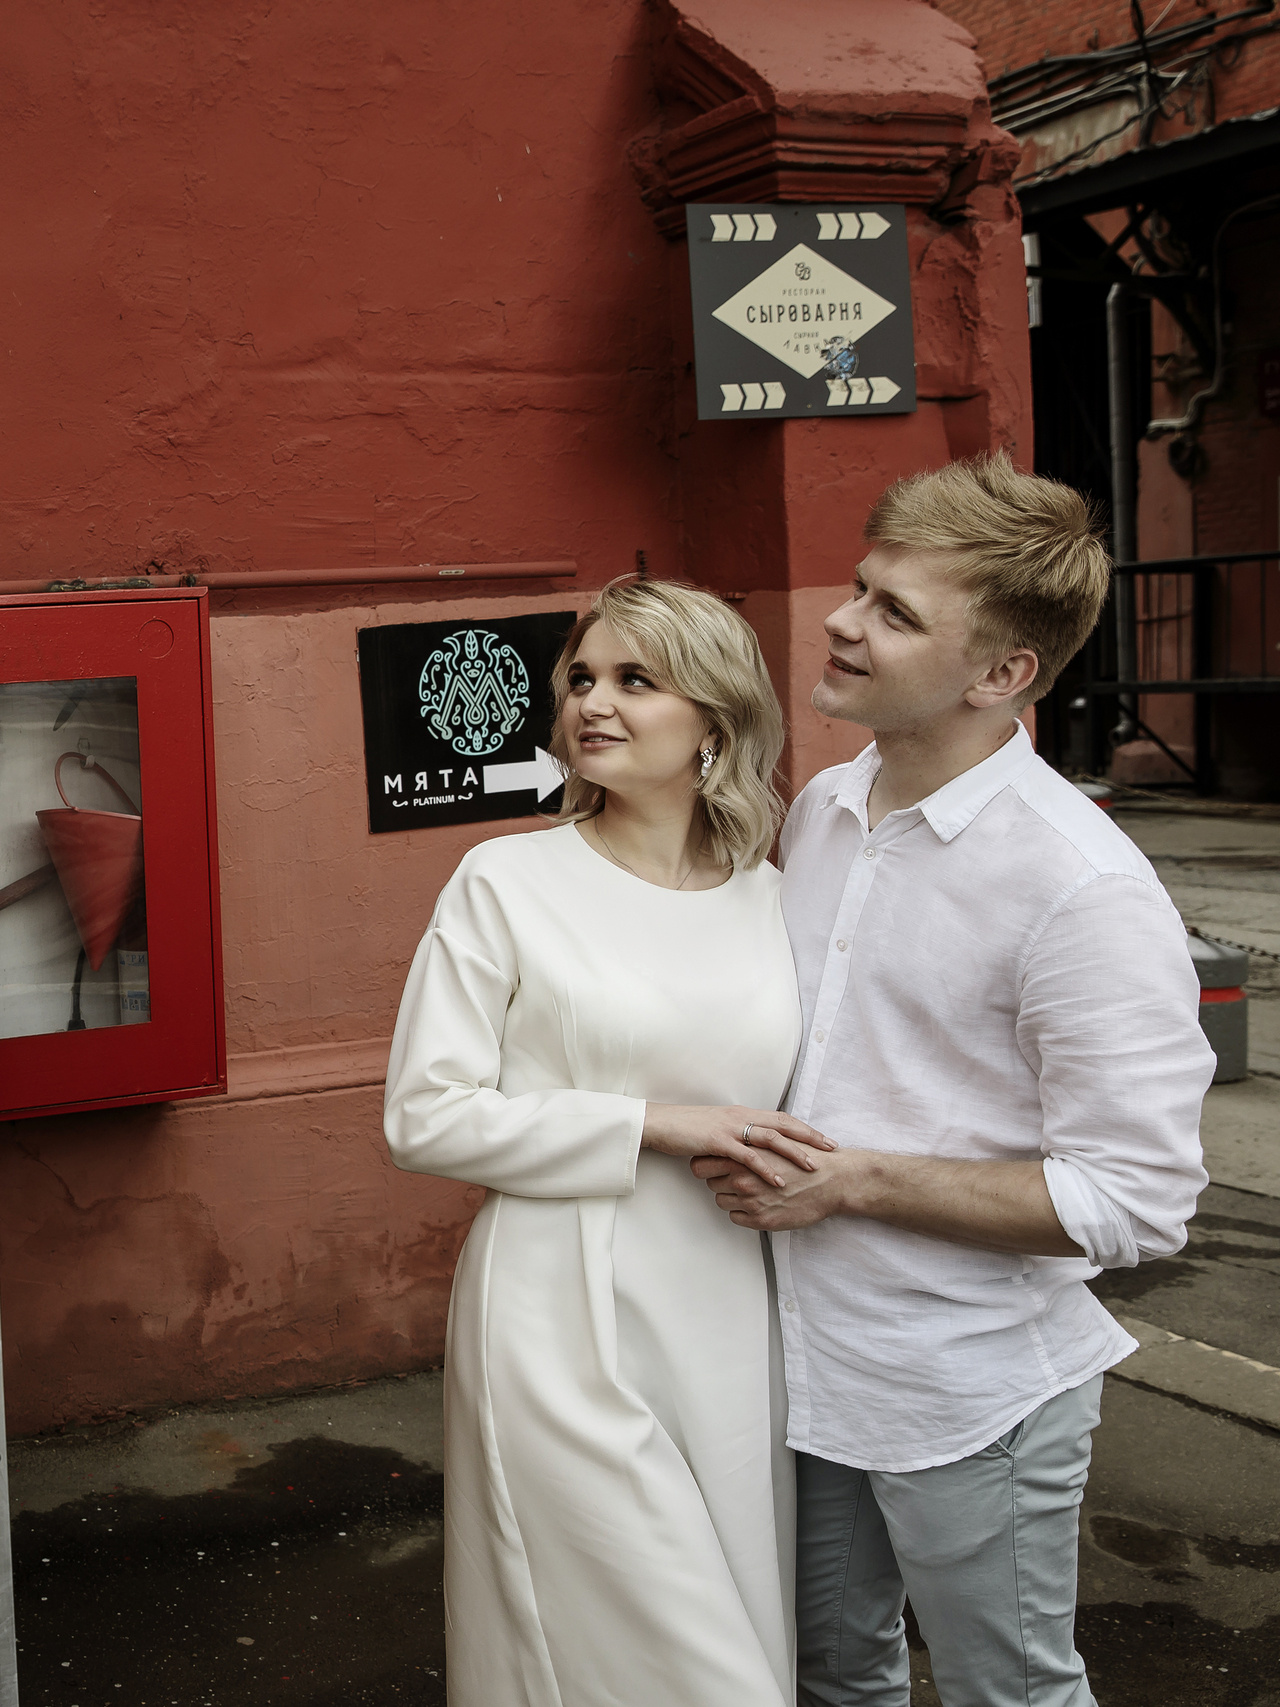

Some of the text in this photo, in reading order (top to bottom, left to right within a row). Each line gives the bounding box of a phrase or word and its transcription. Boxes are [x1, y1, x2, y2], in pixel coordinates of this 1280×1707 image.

[781, 288, 827, 297] РЕСТОРАН
[746, 302, 863, 324] СЫРОВАРНЯ
[383, 766, 479, 795] МЯТА
[413, 794, 455, 807] PLATINUM
